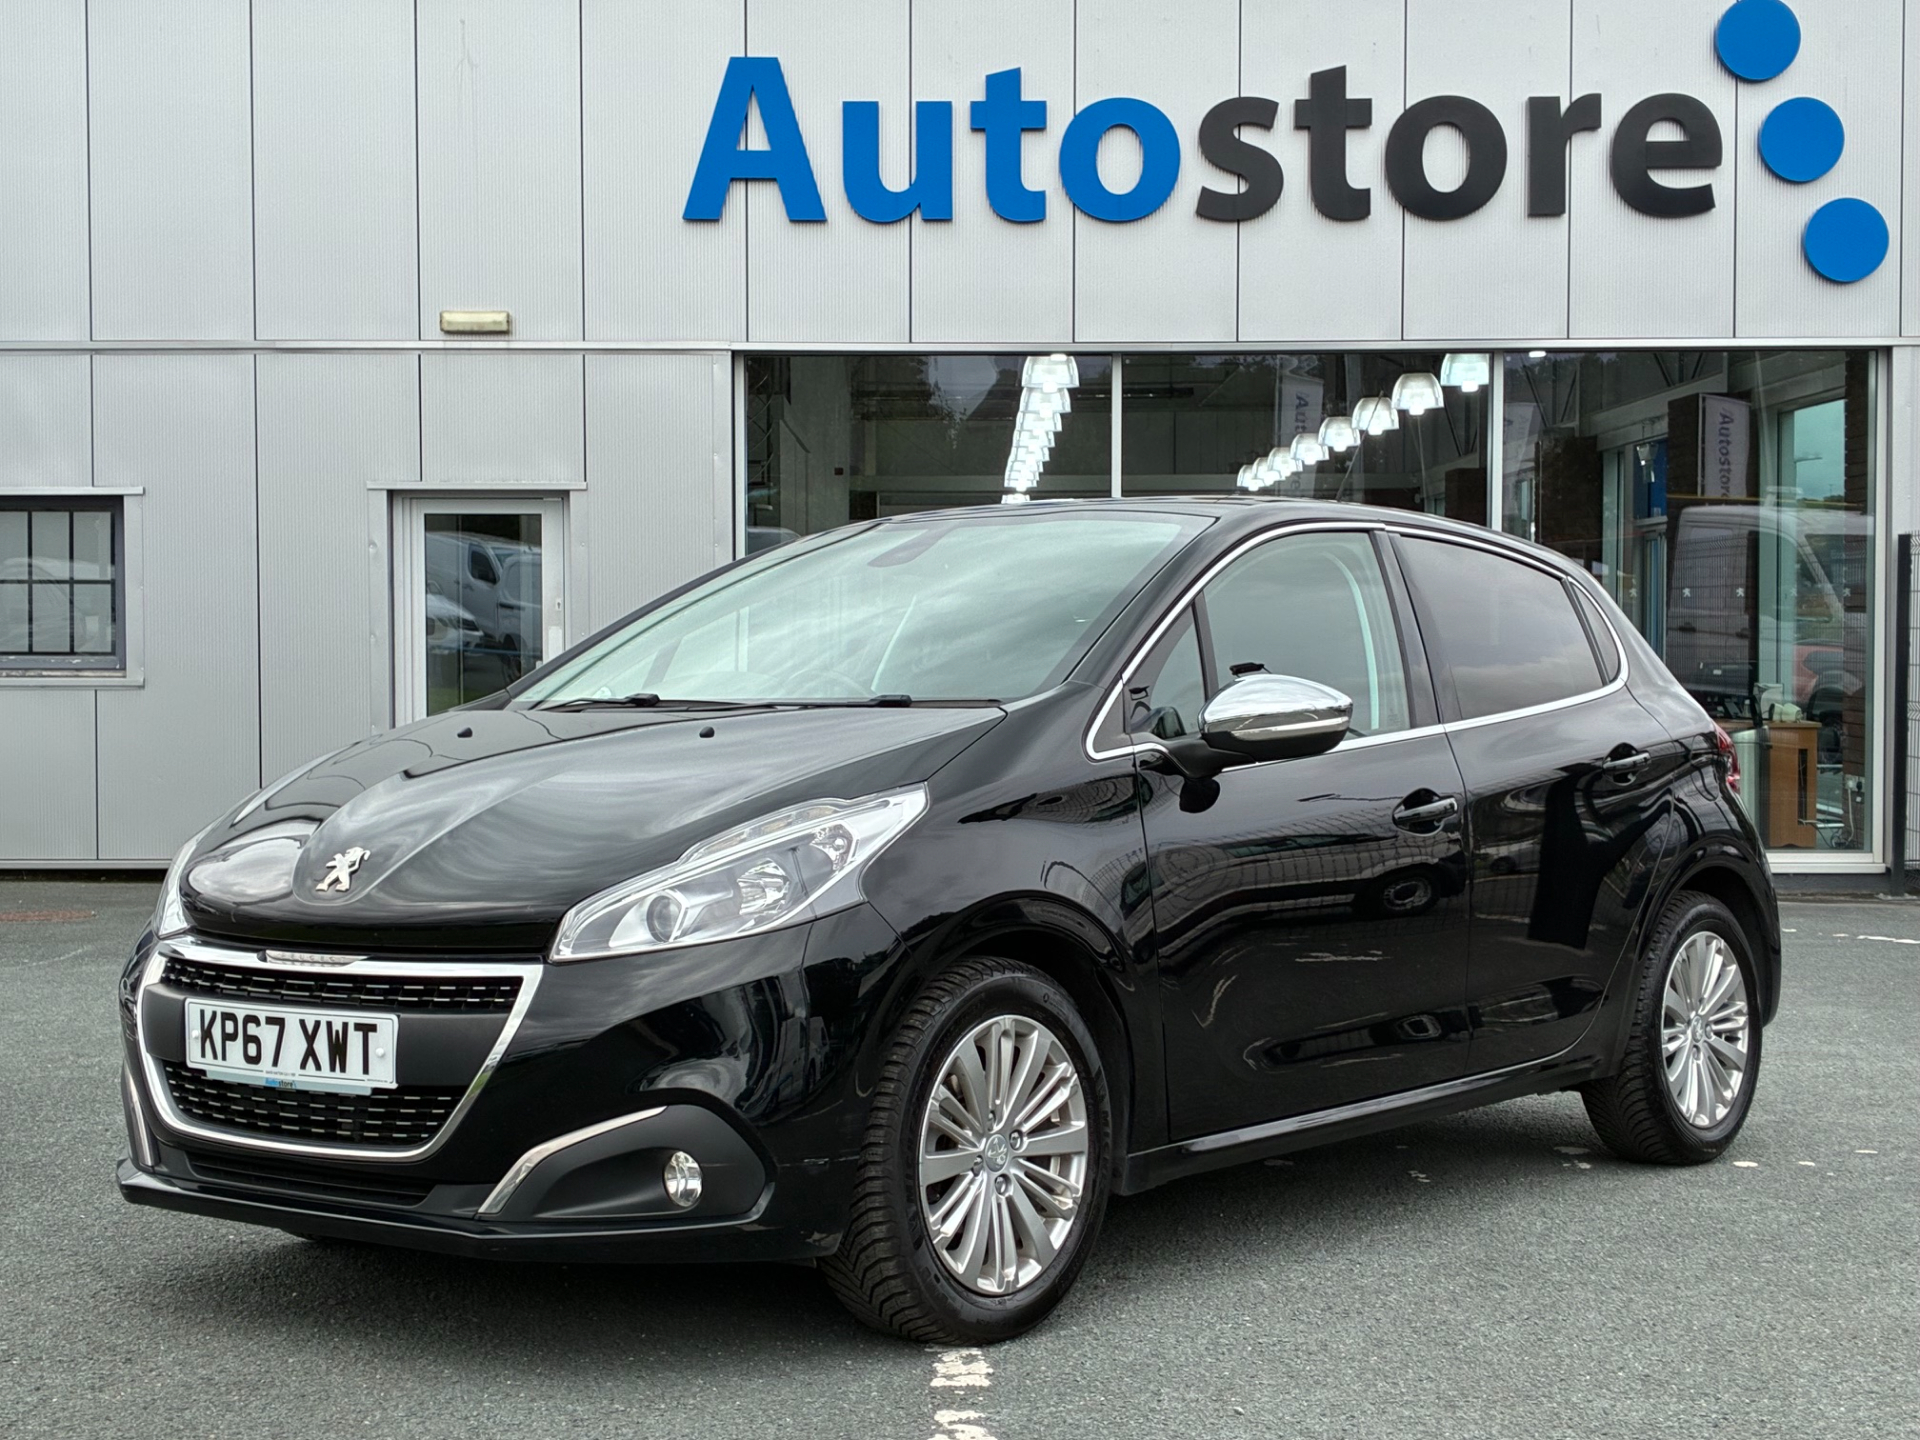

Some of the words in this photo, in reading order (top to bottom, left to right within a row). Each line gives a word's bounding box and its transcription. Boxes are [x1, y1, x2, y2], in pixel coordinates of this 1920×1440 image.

[683, 55, 1722, 223] Autostore
[200, 1009, 285, 1068] KP67
[299, 1018, 377, 1076] XWT
